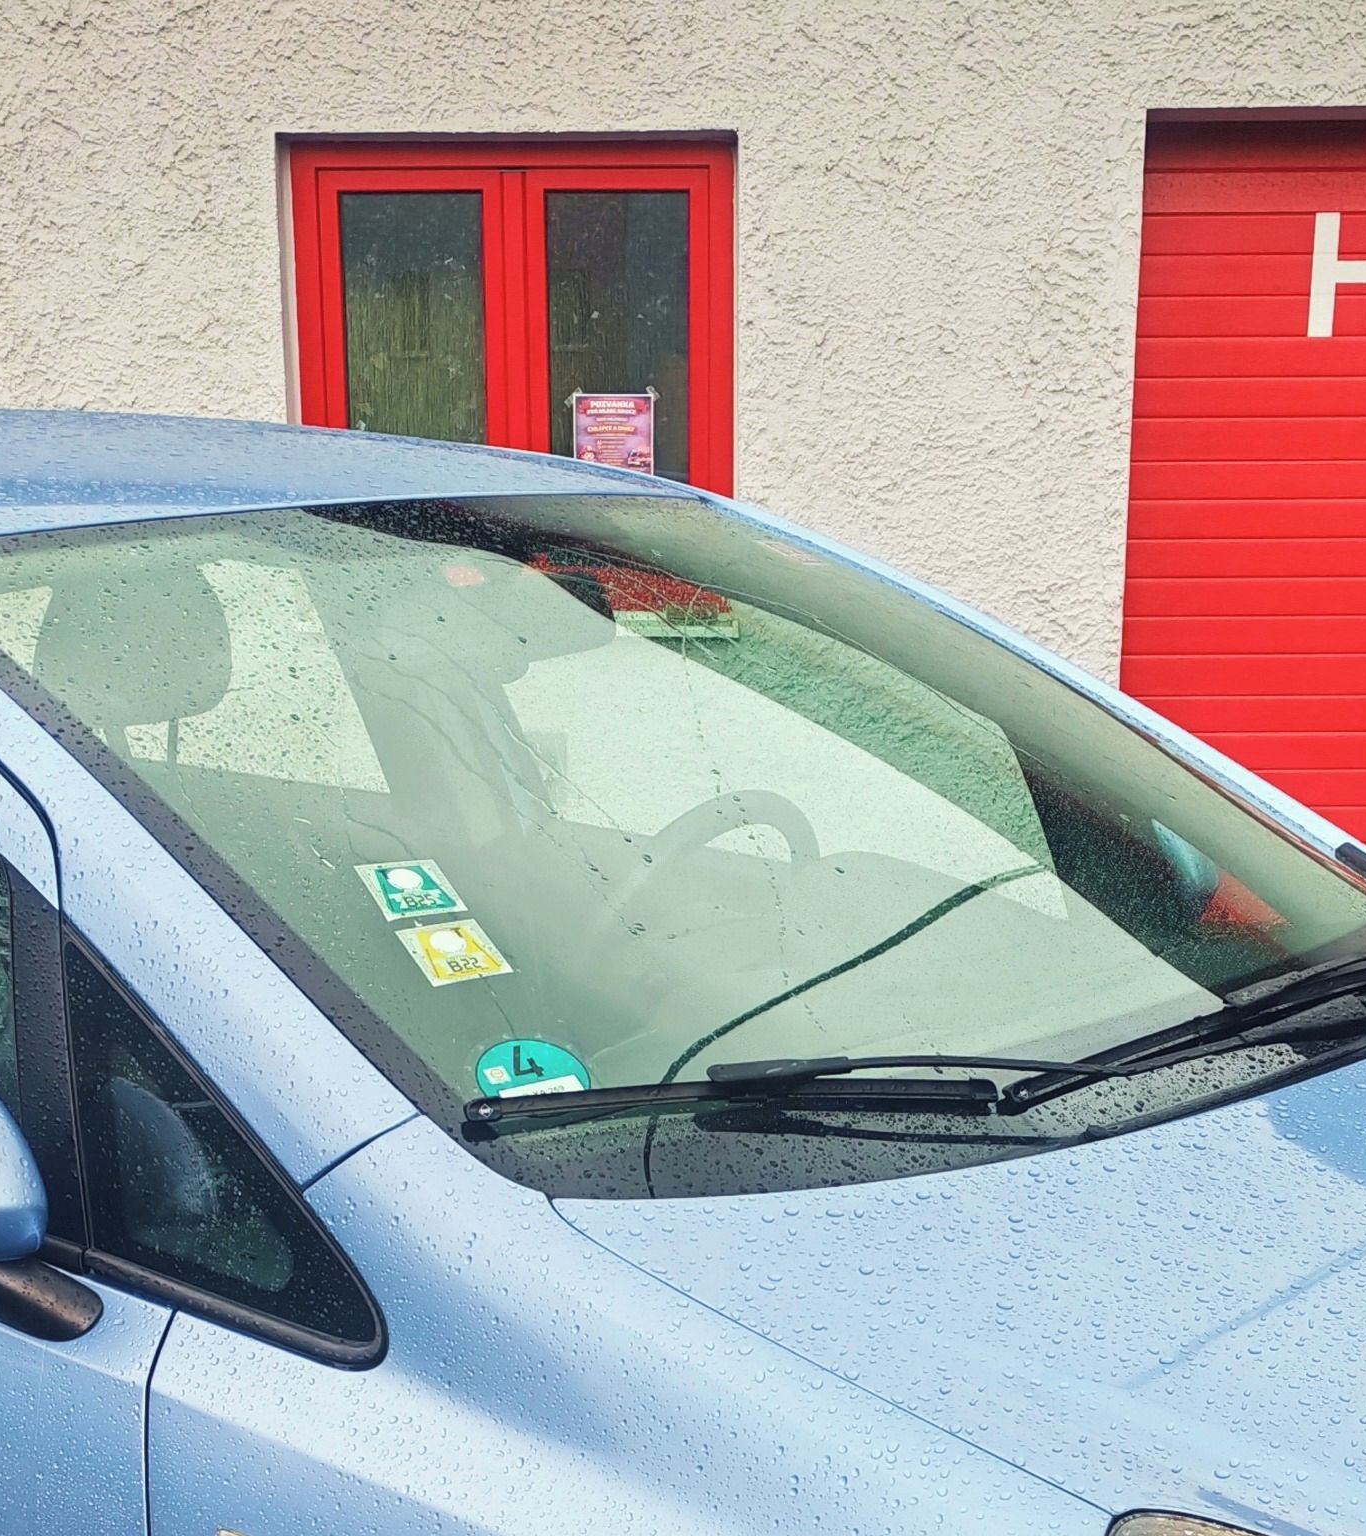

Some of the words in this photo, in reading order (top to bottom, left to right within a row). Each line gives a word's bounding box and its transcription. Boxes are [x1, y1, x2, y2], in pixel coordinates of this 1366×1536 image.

[404, 894, 437, 908] B25
[447, 957, 482, 973] B22
[512, 1045, 545, 1078] 4
